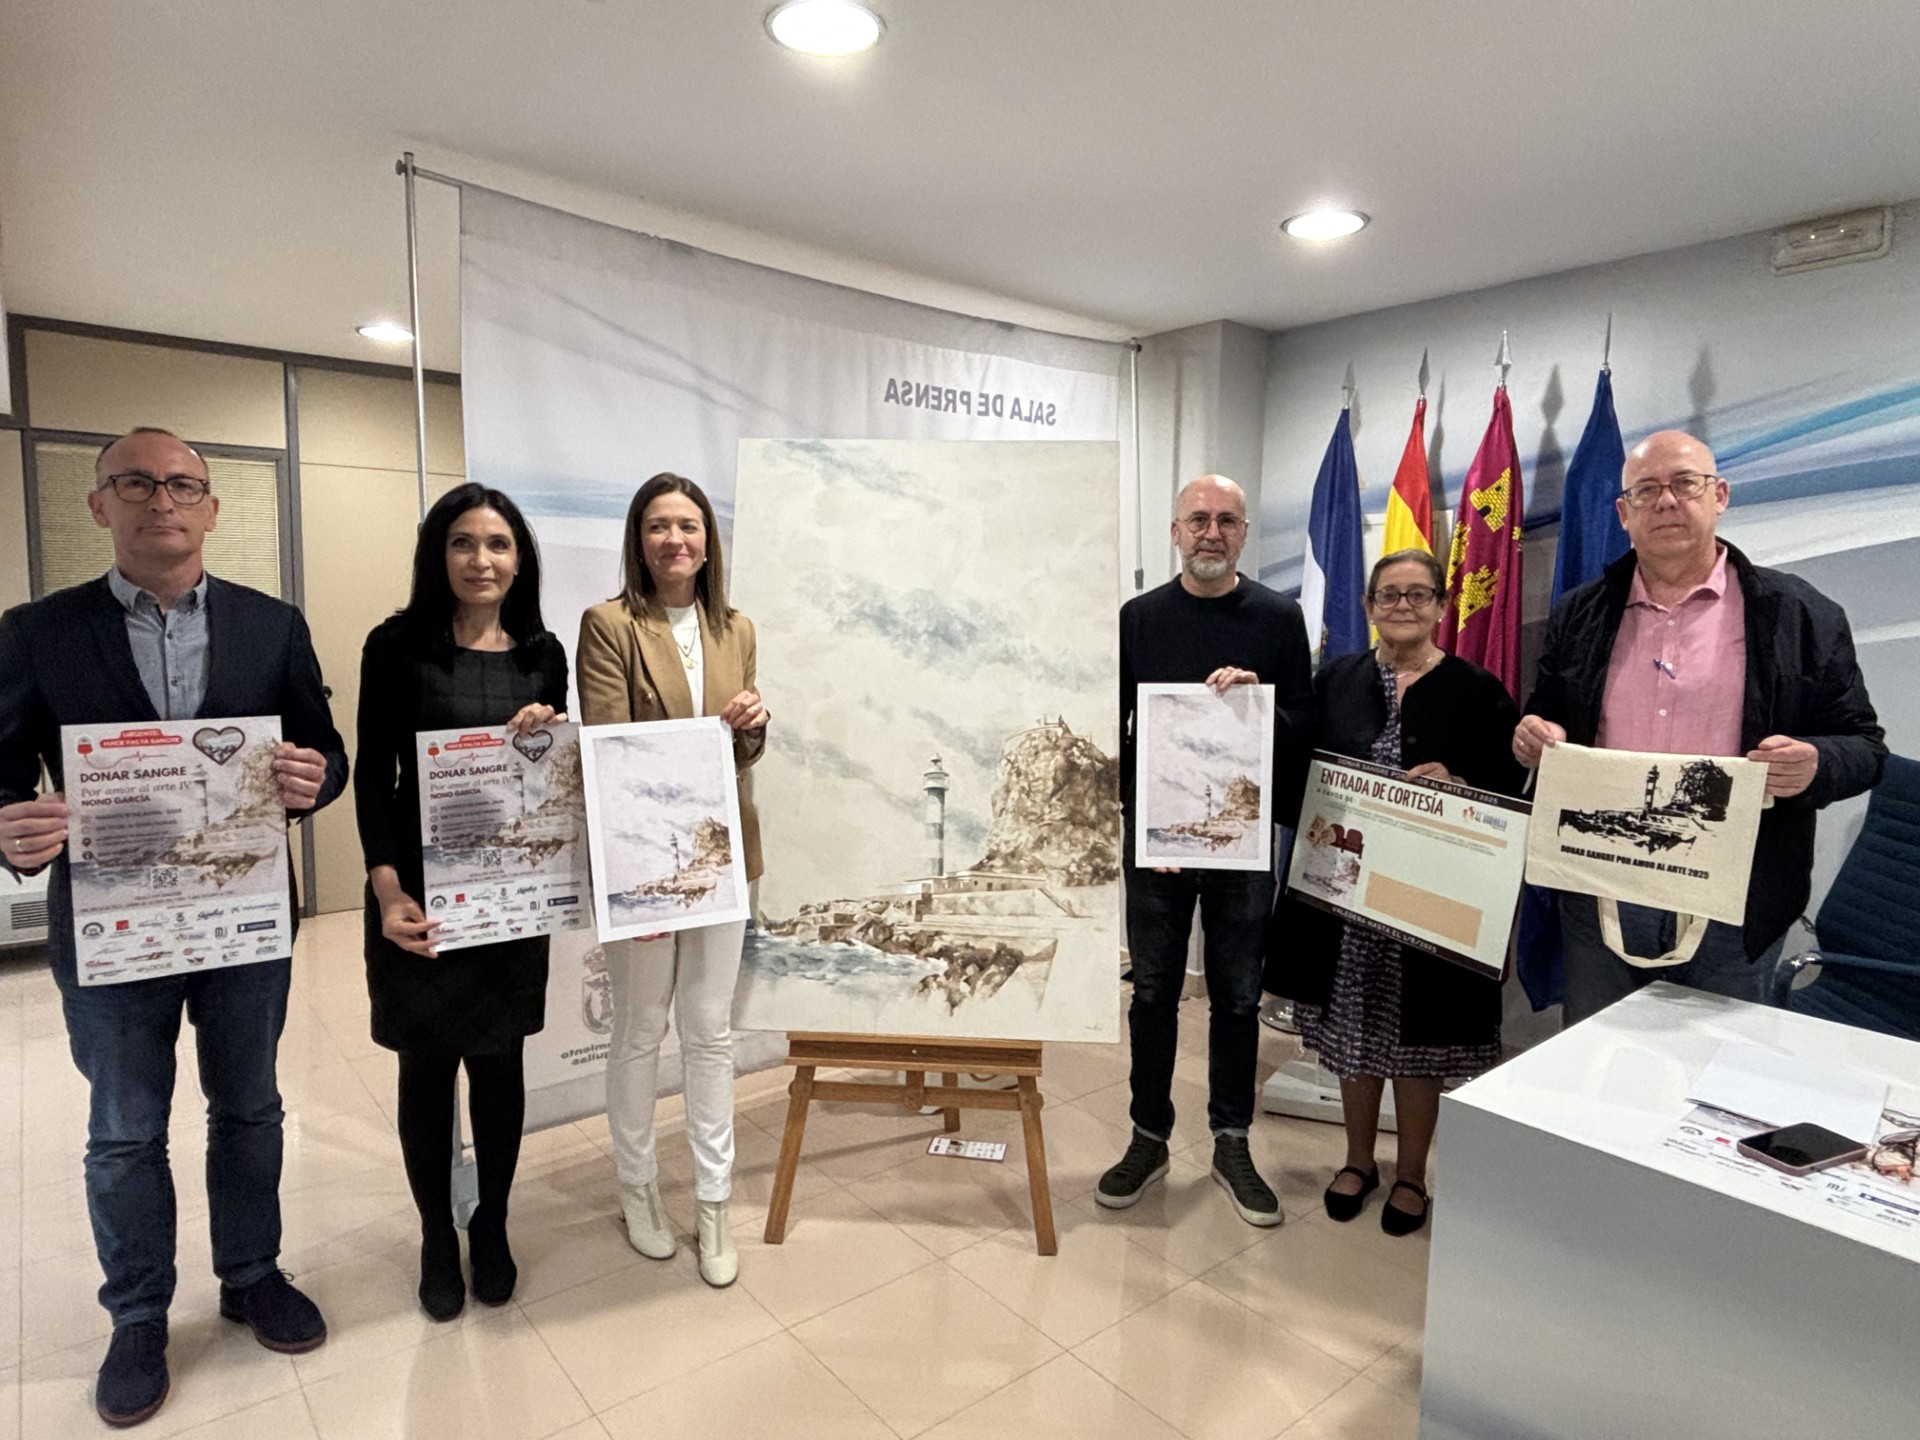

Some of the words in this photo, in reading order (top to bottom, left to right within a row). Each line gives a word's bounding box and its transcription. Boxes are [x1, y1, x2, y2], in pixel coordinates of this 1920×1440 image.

[80, 770, 130, 783] DONAR
[133, 766, 187, 780] SANGRE
[429, 768, 466, 780] DONAR
[468, 763, 508, 776] SANGRE
[1362, 763, 1389, 775] SANGRE
[1431, 780, 1440, 789] AL
[1442, 783, 1462, 795] ARTE
[81, 787, 102, 798] Por
[105, 785, 135, 796] amor
[153, 782, 176, 791] arte
[1320, 767, 1370, 796] ENTRADA
[1371, 781, 1387, 800] DE
[1387, 785, 1444, 817] CORTESÍA
[81, 798, 112, 806] NONO
[1560, 844, 1585, 856] DONAR
[1586, 850, 1615, 863] SANGRE
[1616, 855, 1631, 866] POR
[1632, 858, 1656, 869] AMOR
[1656, 862, 1666, 871] AL
[1667, 864, 1687, 876] ARTE
[1688, 868, 1709, 880] 2025
[1367, 920, 1391, 934] HASTA
[1392, 929, 1401, 939] EL
